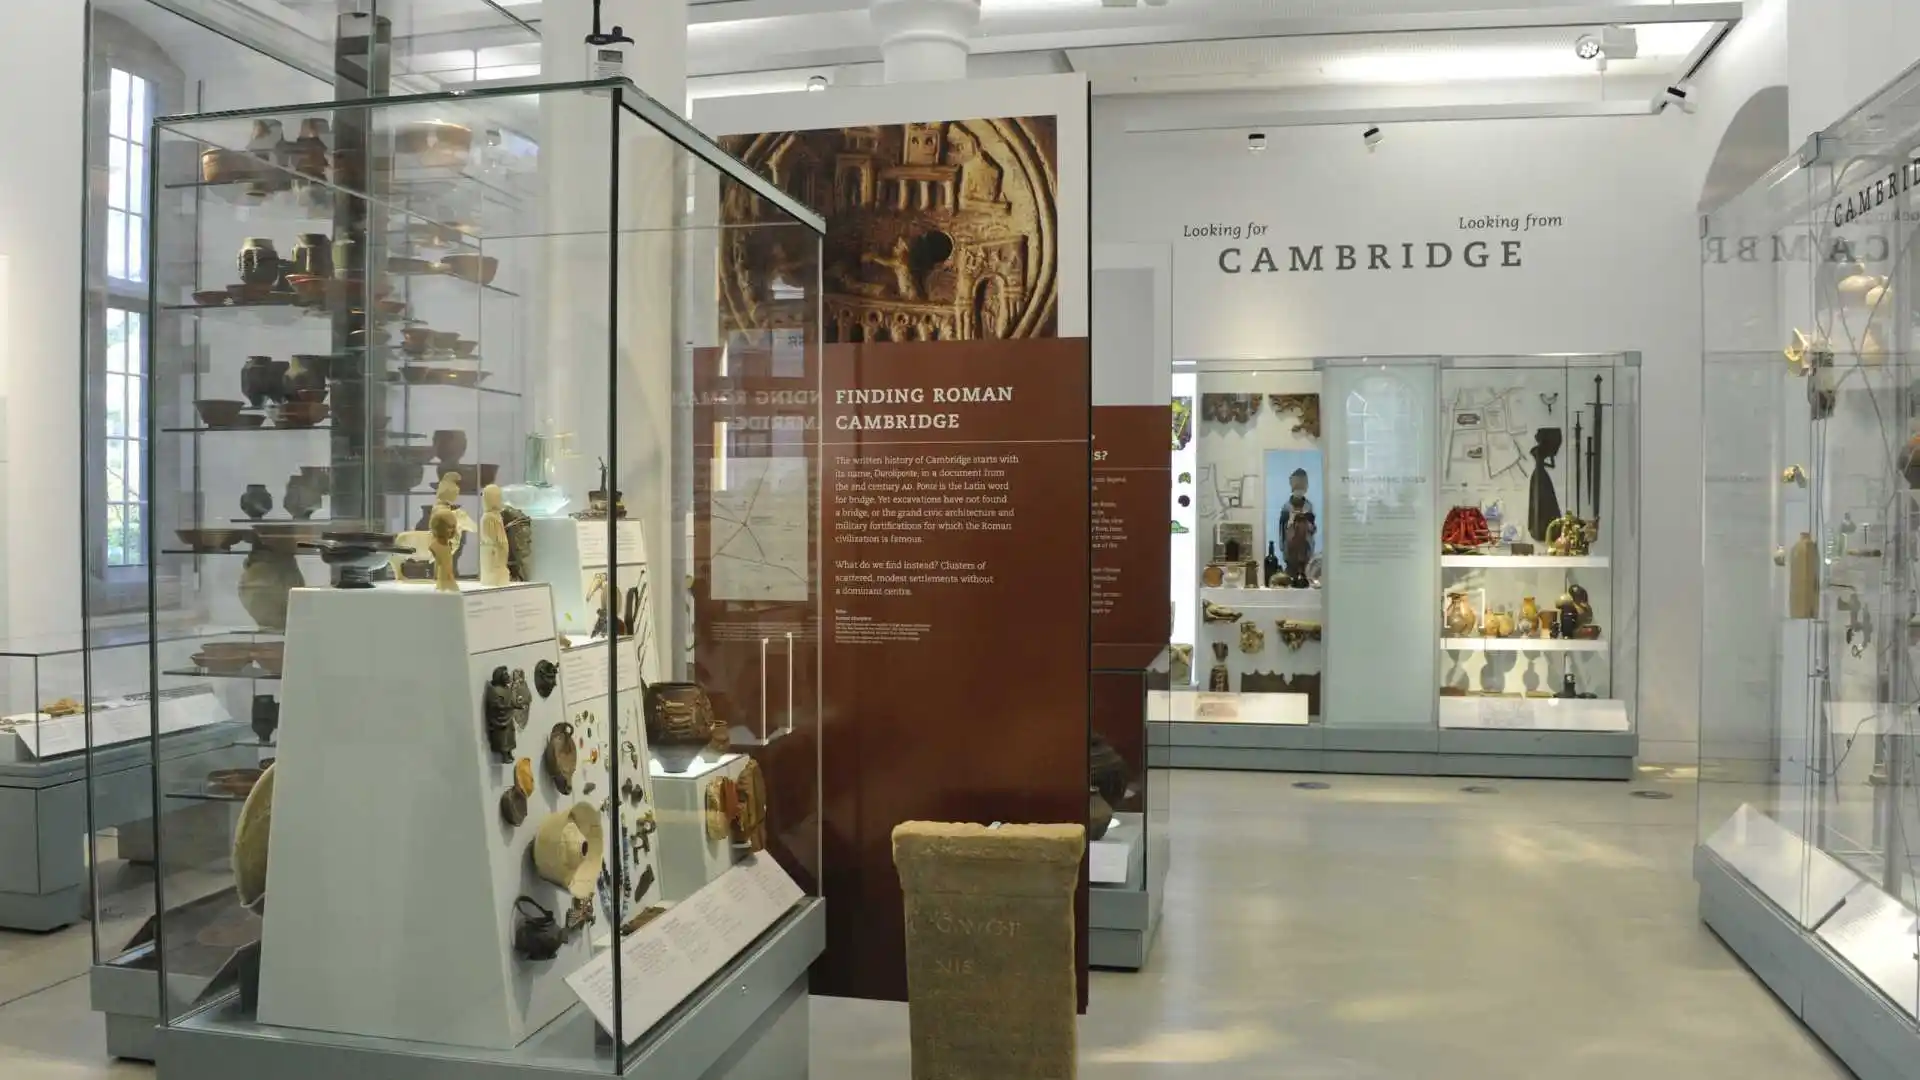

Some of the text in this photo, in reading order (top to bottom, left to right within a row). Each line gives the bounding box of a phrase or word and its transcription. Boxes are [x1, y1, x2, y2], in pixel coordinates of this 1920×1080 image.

[1458, 213, 1563, 231] Looking from
[1183, 222, 1268, 239] Looking for
[1218, 240, 1523, 274] CAMBRIDGE
[836, 386, 1013, 404] FINDING ROMAN
[836, 414, 960, 430] CAMBRIDGE
[836, 457, 850, 465] The
[884, 456, 913, 466] history
[916, 456, 924, 464] of
[926, 456, 971, 466] Cambridge
[1001, 456, 1019, 464] with
[836, 470, 845, 478] its
[939, 469, 981, 477] document
[984, 469, 1004, 477] from
[836, 483, 848, 491] the
[868, 483, 899, 492] century
[948, 482, 962, 490] the
[964, 482, 985, 490] Latin
[988, 482, 1008, 490] word
[836, 496, 847, 504] for
[849, 496, 876, 506] bridge.
[893, 496, 941, 504] excavations
[944, 496, 964, 504] have
[966, 496, 980, 504] not
[982, 495, 1007, 503] found
[842, 509, 870, 519] bridge,
[882, 509, 896, 517] the
[898, 509, 921, 519] grand
[923, 509, 943, 517] civic
[945, 509, 996, 517] architecture
[999, 509, 1015, 517] and
[836, 522, 1012, 532] military fortifications for which the Roman
[836, 535, 923, 543] civilization is famous.
[835, 561, 858, 569] What
[859, 561, 870, 569] do
[886, 561, 902, 569] find
[904, 561, 939, 569] instead?
[941, 561, 975, 570] Clusters
[978, 562, 987, 570] of
[835, 575, 994, 583] scattered, modest settlements without
[842, 587, 882, 595] dominant
[884, 588, 912, 596] centre.
